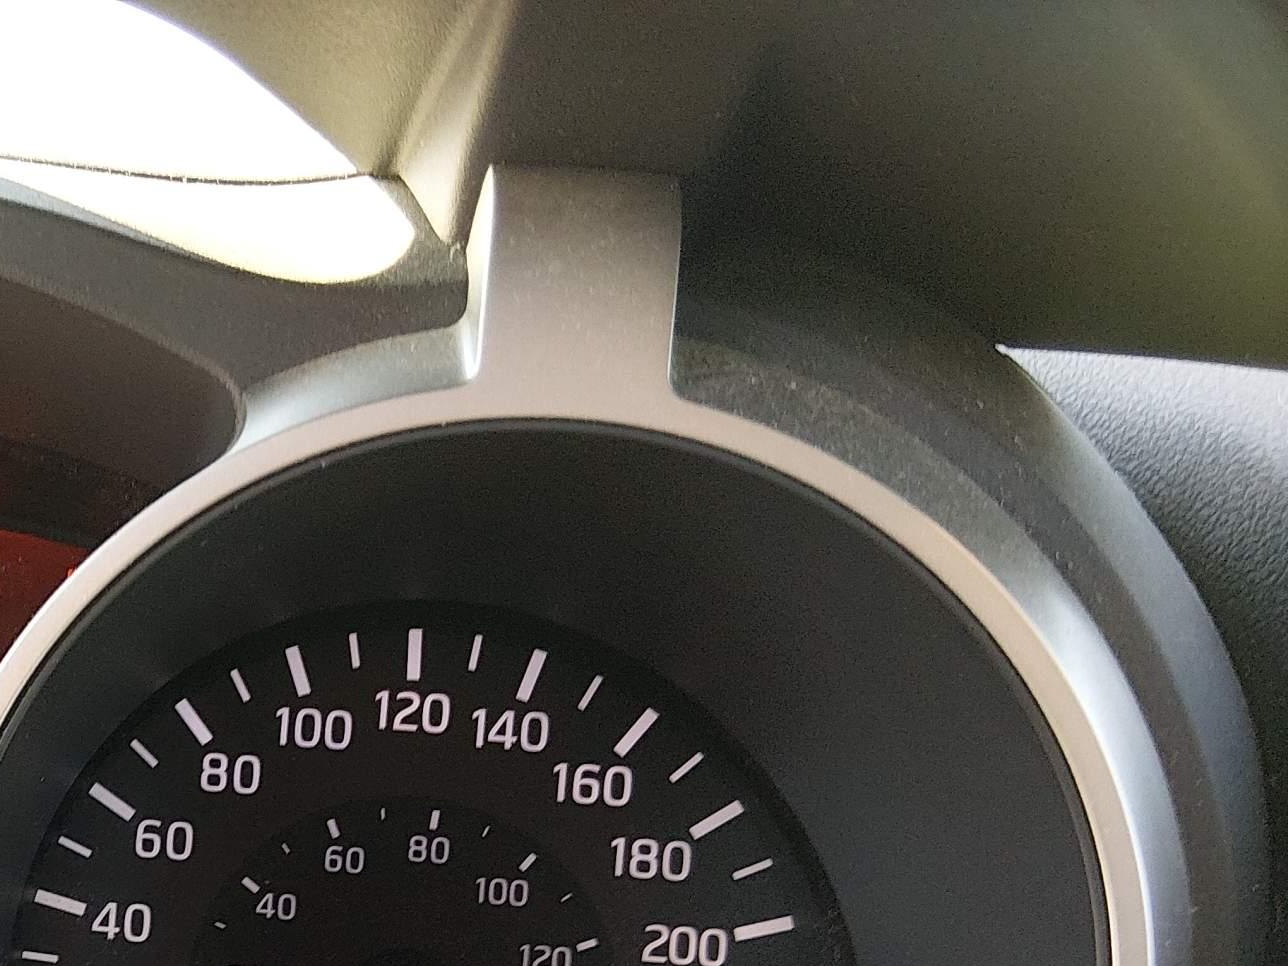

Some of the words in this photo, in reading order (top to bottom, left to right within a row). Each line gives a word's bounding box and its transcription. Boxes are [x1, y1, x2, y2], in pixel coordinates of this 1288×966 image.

[275, 706, 353, 750] 100
[375, 690, 451, 734] 120
[471, 708, 549, 753] 140
[200, 752, 261, 795] 80
[553, 762, 633, 807] 160
[135, 819, 194, 861] 60
[324, 845, 365, 874] 60
[407, 835, 450, 864] 80
[610, 837, 692, 882] 180
[255, 892, 297, 921] 40
[475, 877, 529, 907] 100
[91, 902, 151, 943] 40
